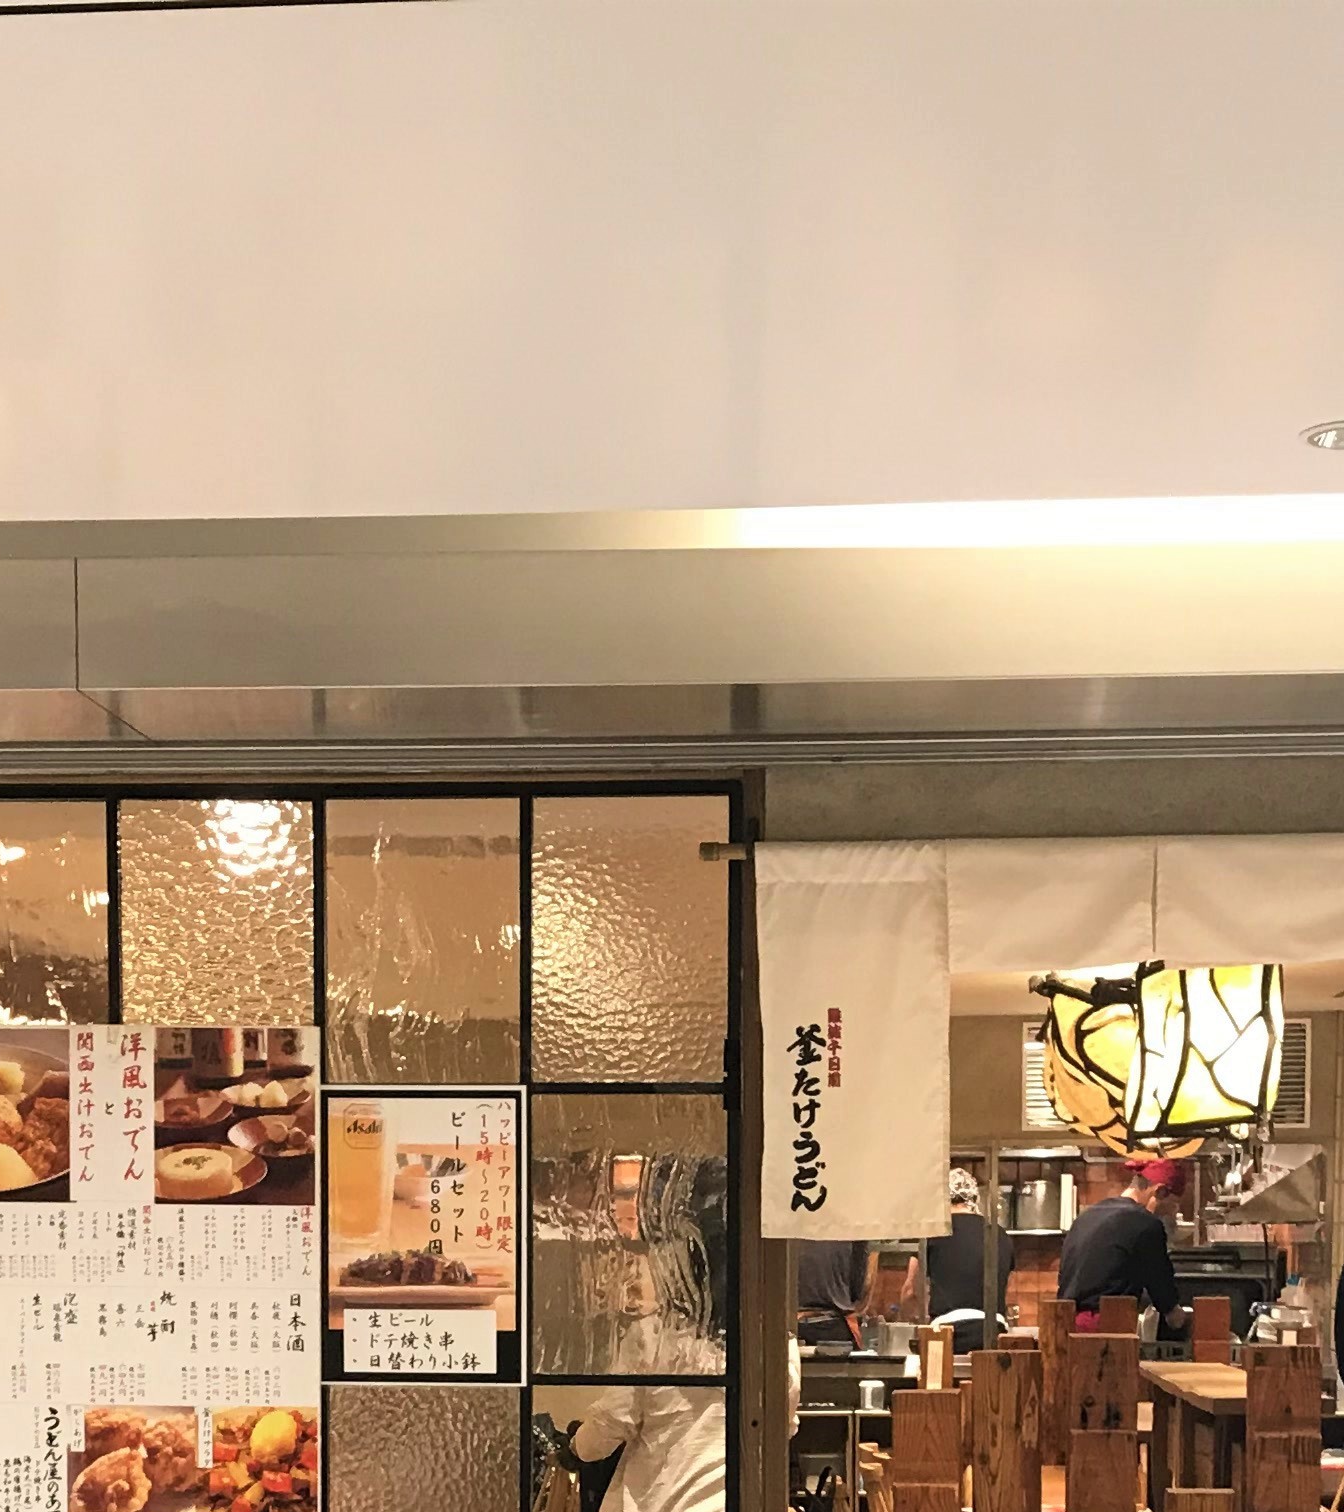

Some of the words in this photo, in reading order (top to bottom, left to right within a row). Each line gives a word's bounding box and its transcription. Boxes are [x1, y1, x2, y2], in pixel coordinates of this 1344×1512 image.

[77, 1032, 94, 1182] 関西出汁おでん
[105, 1103, 114, 1115] と
[121, 1032, 147, 1181] 洋風おでん
[786, 1023, 827, 1212] 釜たけうどん
[451, 1112, 467, 1243] ビールセット
[497, 1101, 514, 1254] ハッピーアワー限定
[429, 1180, 444, 1254] 680円
[287, 1293, 306, 1352] 日本酒
[368, 1311, 433, 1327] 生ビール
[369, 1332, 454, 1349] ドテ焼き串
[369, 1352, 480, 1371] 日替わり小鉢
